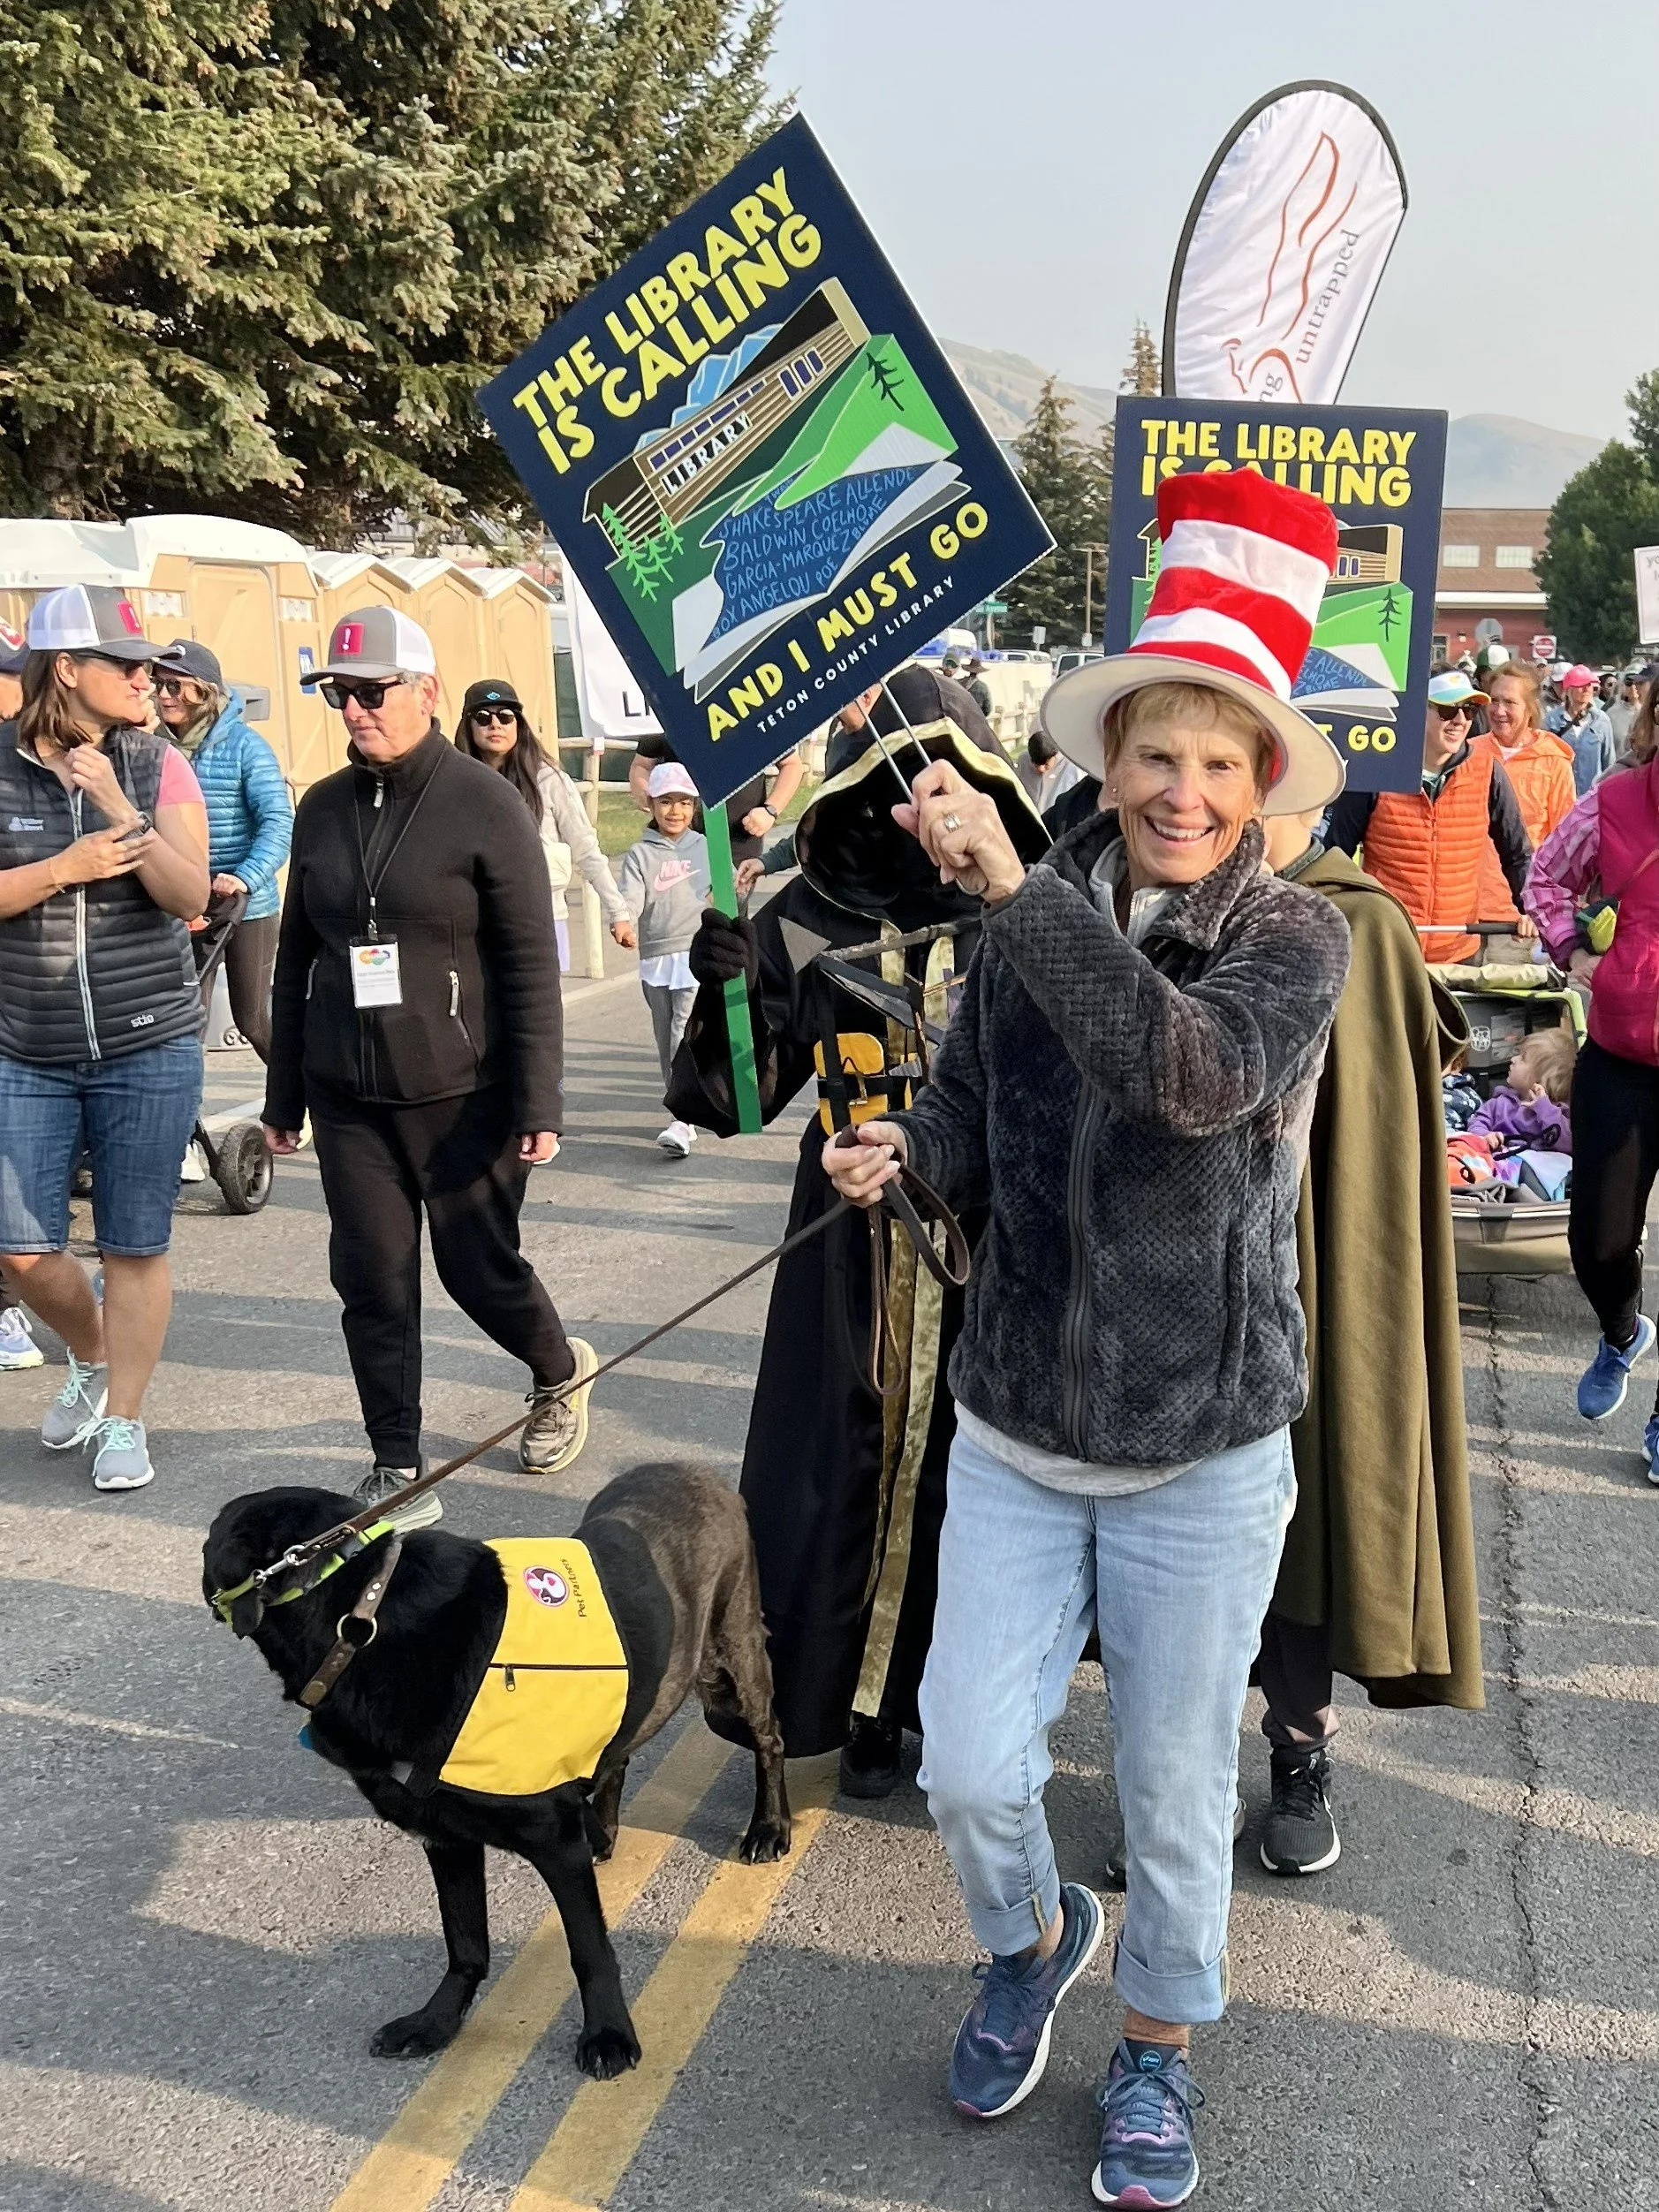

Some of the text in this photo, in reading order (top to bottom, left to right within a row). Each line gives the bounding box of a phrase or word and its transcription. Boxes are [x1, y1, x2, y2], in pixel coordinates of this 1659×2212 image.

[513, 166, 794, 428] THE LIBRARY
[1296, 230, 1360, 364] untrapped
[537, 214, 822, 474] IS CALLING
[663, 413, 750, 496] LIBRARY
[1140, 419, 1416, 466] THE LIBRARY
[719, 468, 915, 538] SHAKESPEARE ALLENDE
[1203, 458, 1412, 507] LLING
[723, 503, 867, 572] BALDWIN COELHO
[724, 495, 887, 599] GARCIA-MARQUEZ BLUME
[708, 502, 989, 741] AND I MUST GO
[739, 572, 811, 618] ANGELOU
[815, 556, 839, 587] POE
[757, 576, 954, 734] TETON COUNTY LIBRARY
[1314, 656, 1368, 686] ALLENDE
[1347, 724, 1397, 752] GO
[131, 1015, 154, 1027] stio
[560, 1558, 587, 1617] Pet Partners
